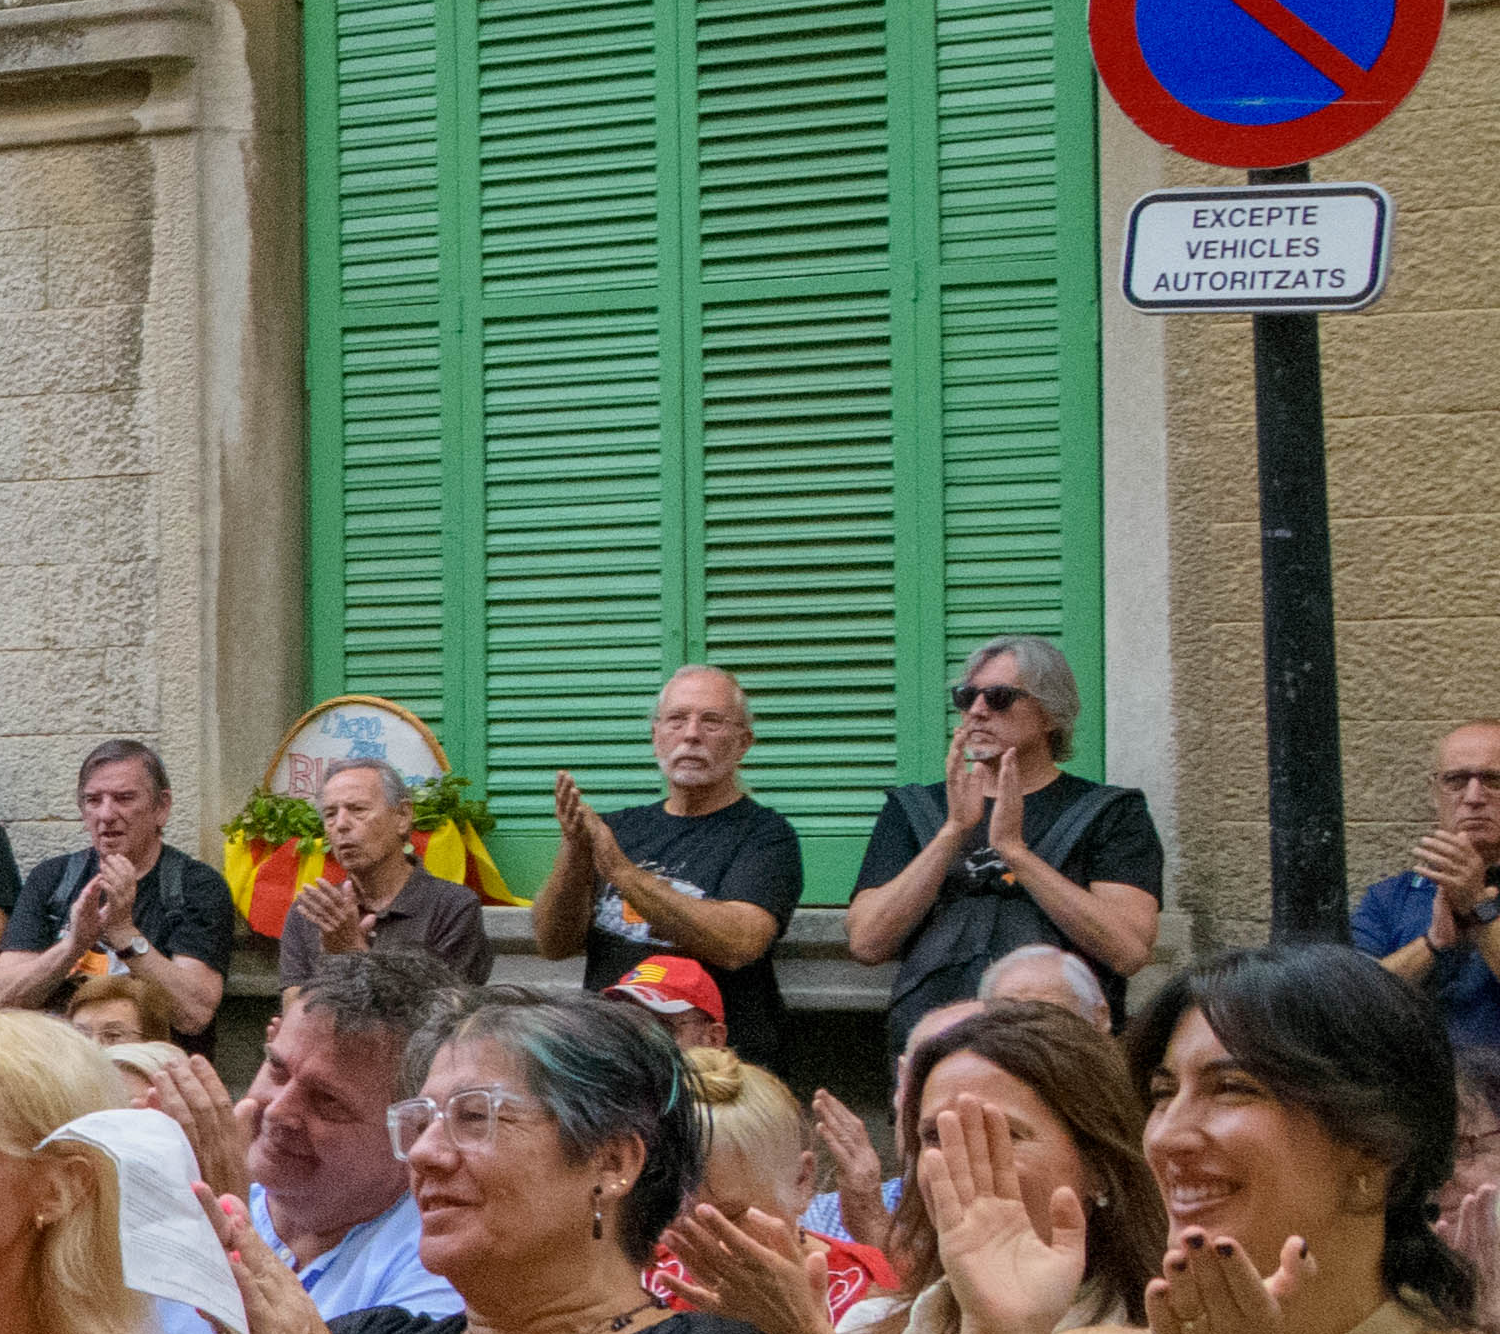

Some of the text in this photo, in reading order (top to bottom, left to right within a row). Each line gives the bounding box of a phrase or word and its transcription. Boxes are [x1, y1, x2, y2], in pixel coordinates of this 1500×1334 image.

[1192, 205, 1319, 230] EXCEPTE
[1185, 237, 1321, 261] VEHICLES
[1153, 267, 1347, 293] AUTORITZATS
